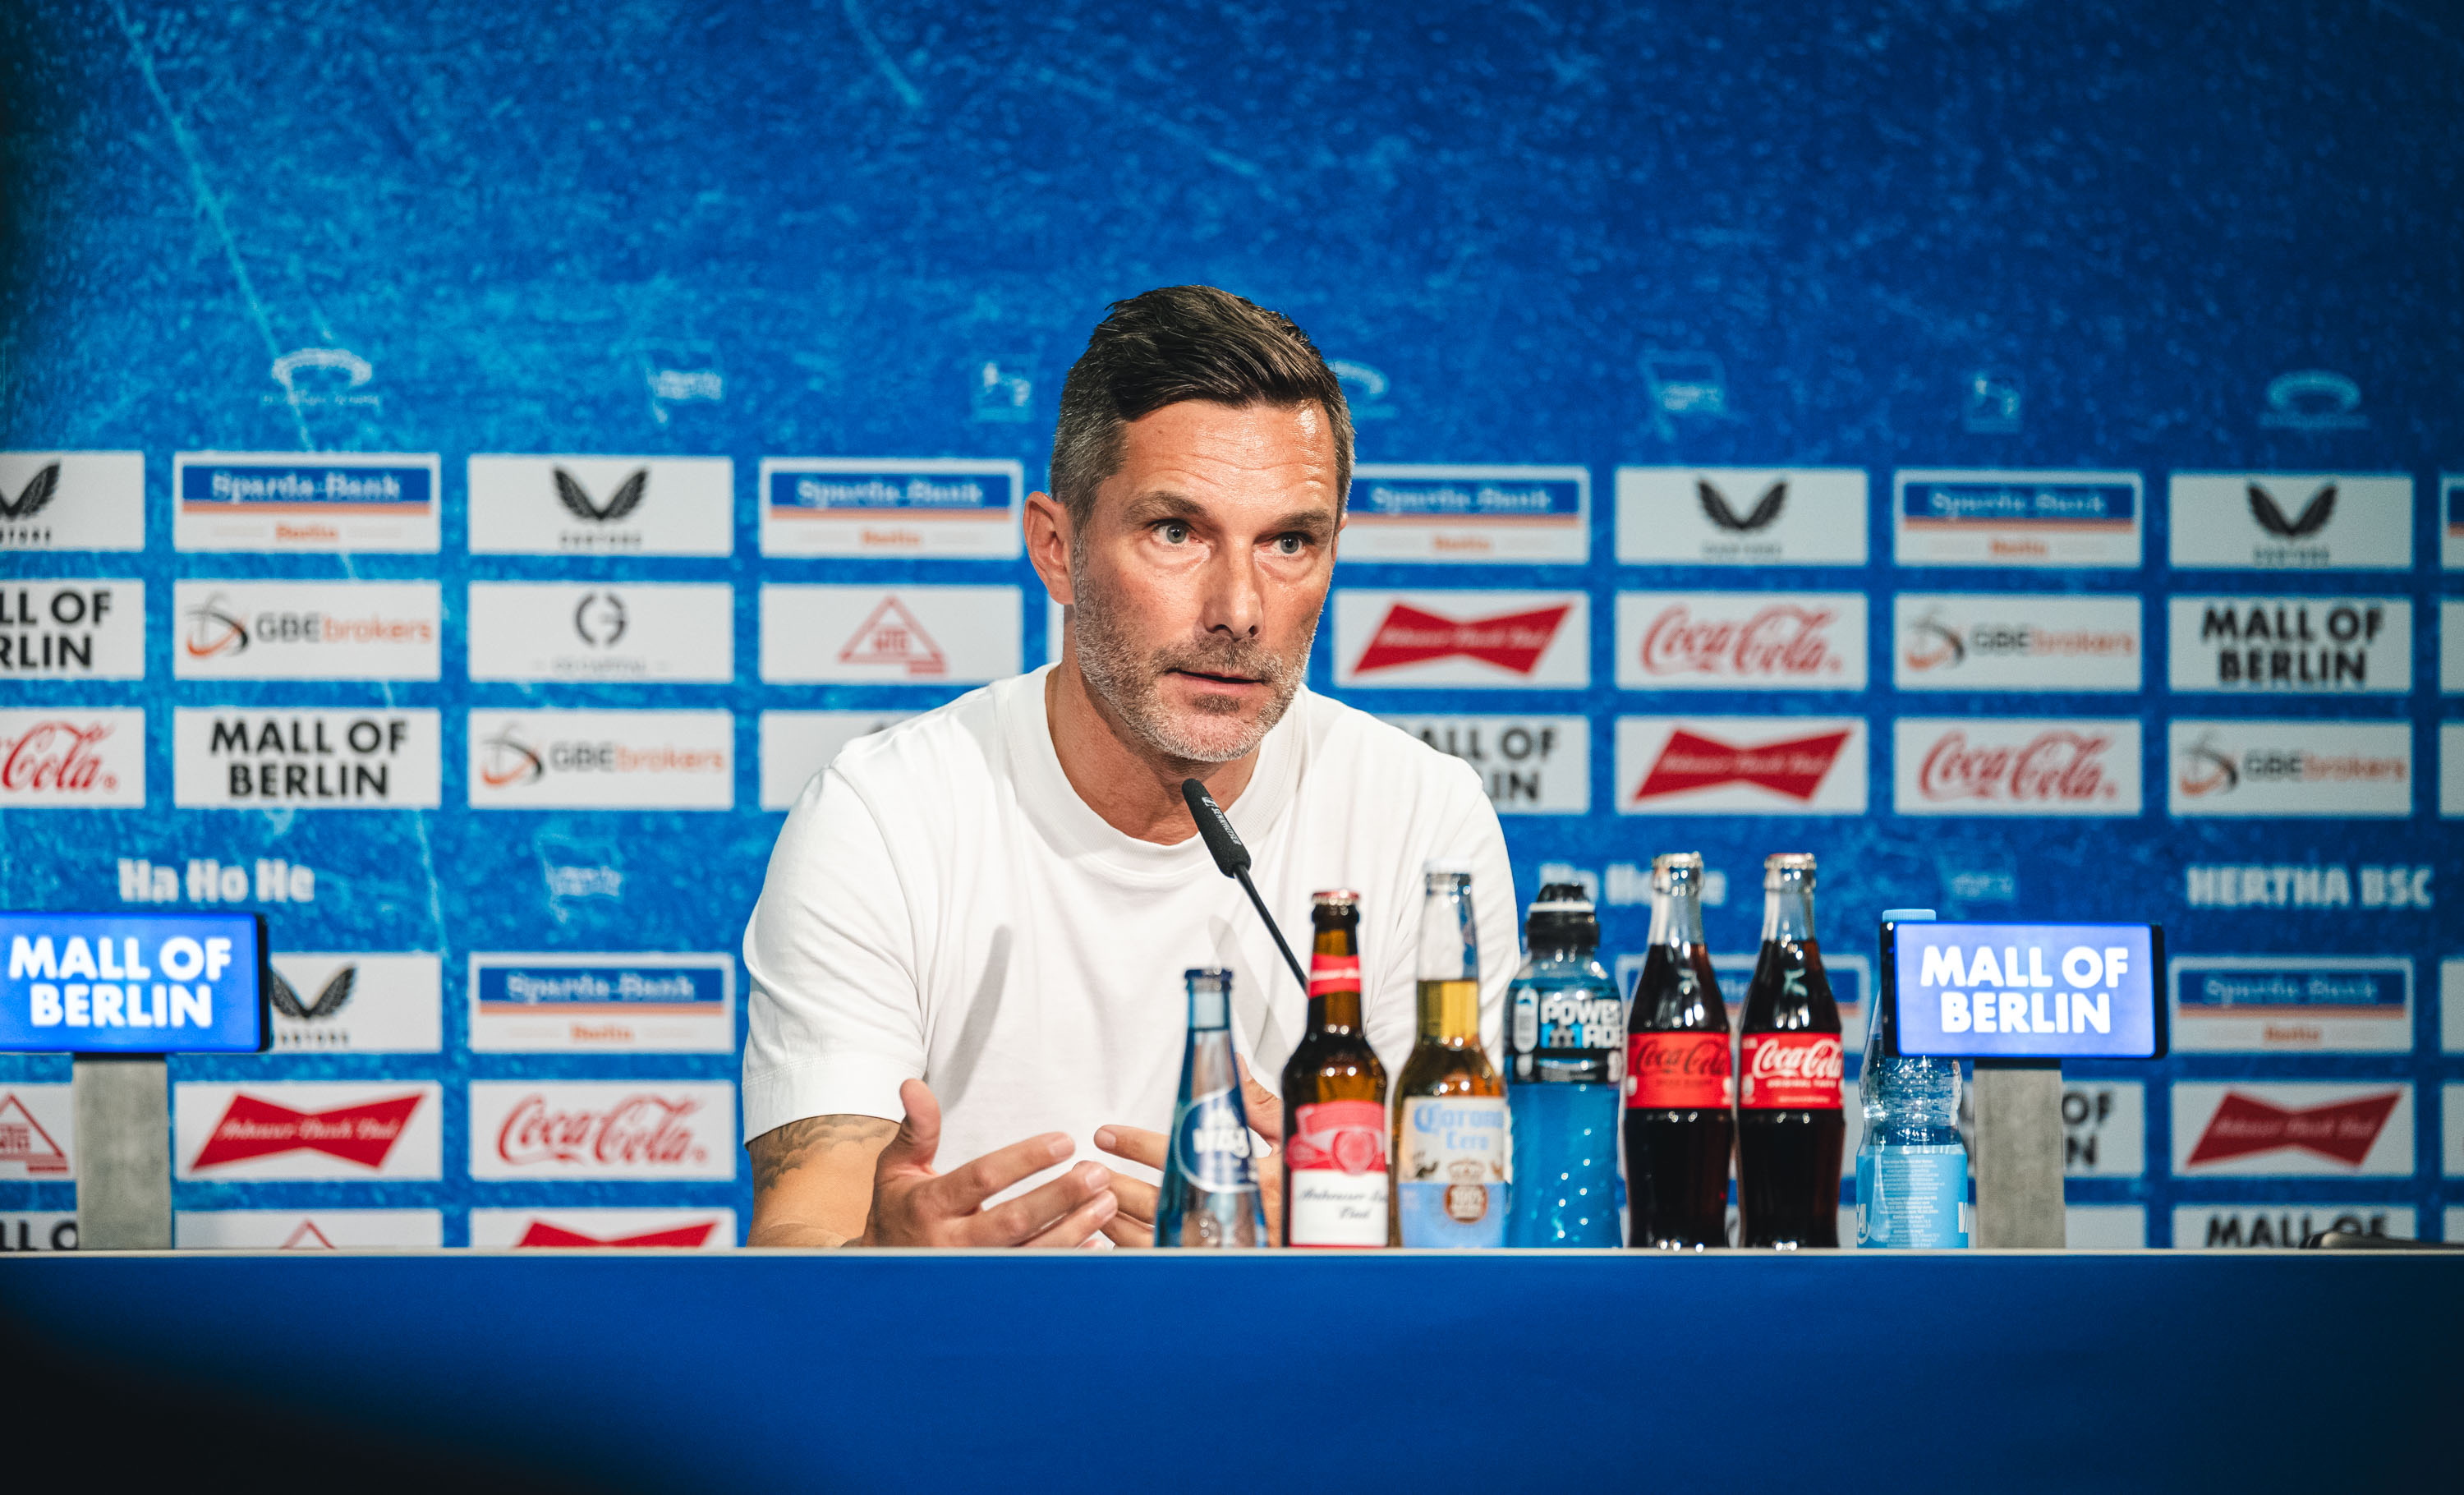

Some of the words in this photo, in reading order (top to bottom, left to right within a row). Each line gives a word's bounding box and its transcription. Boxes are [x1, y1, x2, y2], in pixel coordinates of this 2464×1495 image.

[50, 589, 113, 626] OF
[2201, 606, 2316, 643] MALL
[2328, 606, 2384, 644] OF
[0, 633, 92, 670] RLIN
[2218, 648, 2366, 684] BERLIN
[209, 719, 334, 756] MALL
[347, 719, 409, 756] OF
[1398, 724, 1488, 761] ALL
[1501, 725, 1556, 762] OF
[228, 762, 389, 799] BERLIN
[117, 858, 178, 902] Ha
[186, 858, 247, 902] Ho
[255, 858, 315, 902] He
[2186, 866, 2350, 906] HERTHA
[2361, 867, 2433, 906] BSC
[8, 936, 151, 981] MALL
[159, 936, 232, 982] OF
[1920, 945, 2053, 987] MALL
[2062, 946, 2129, 989] OF
[30, 983, 213, 1028] BERLIN
[1941, 991, 2111, 1033] BERLIN
[50, 1220, 79, 1250] O
